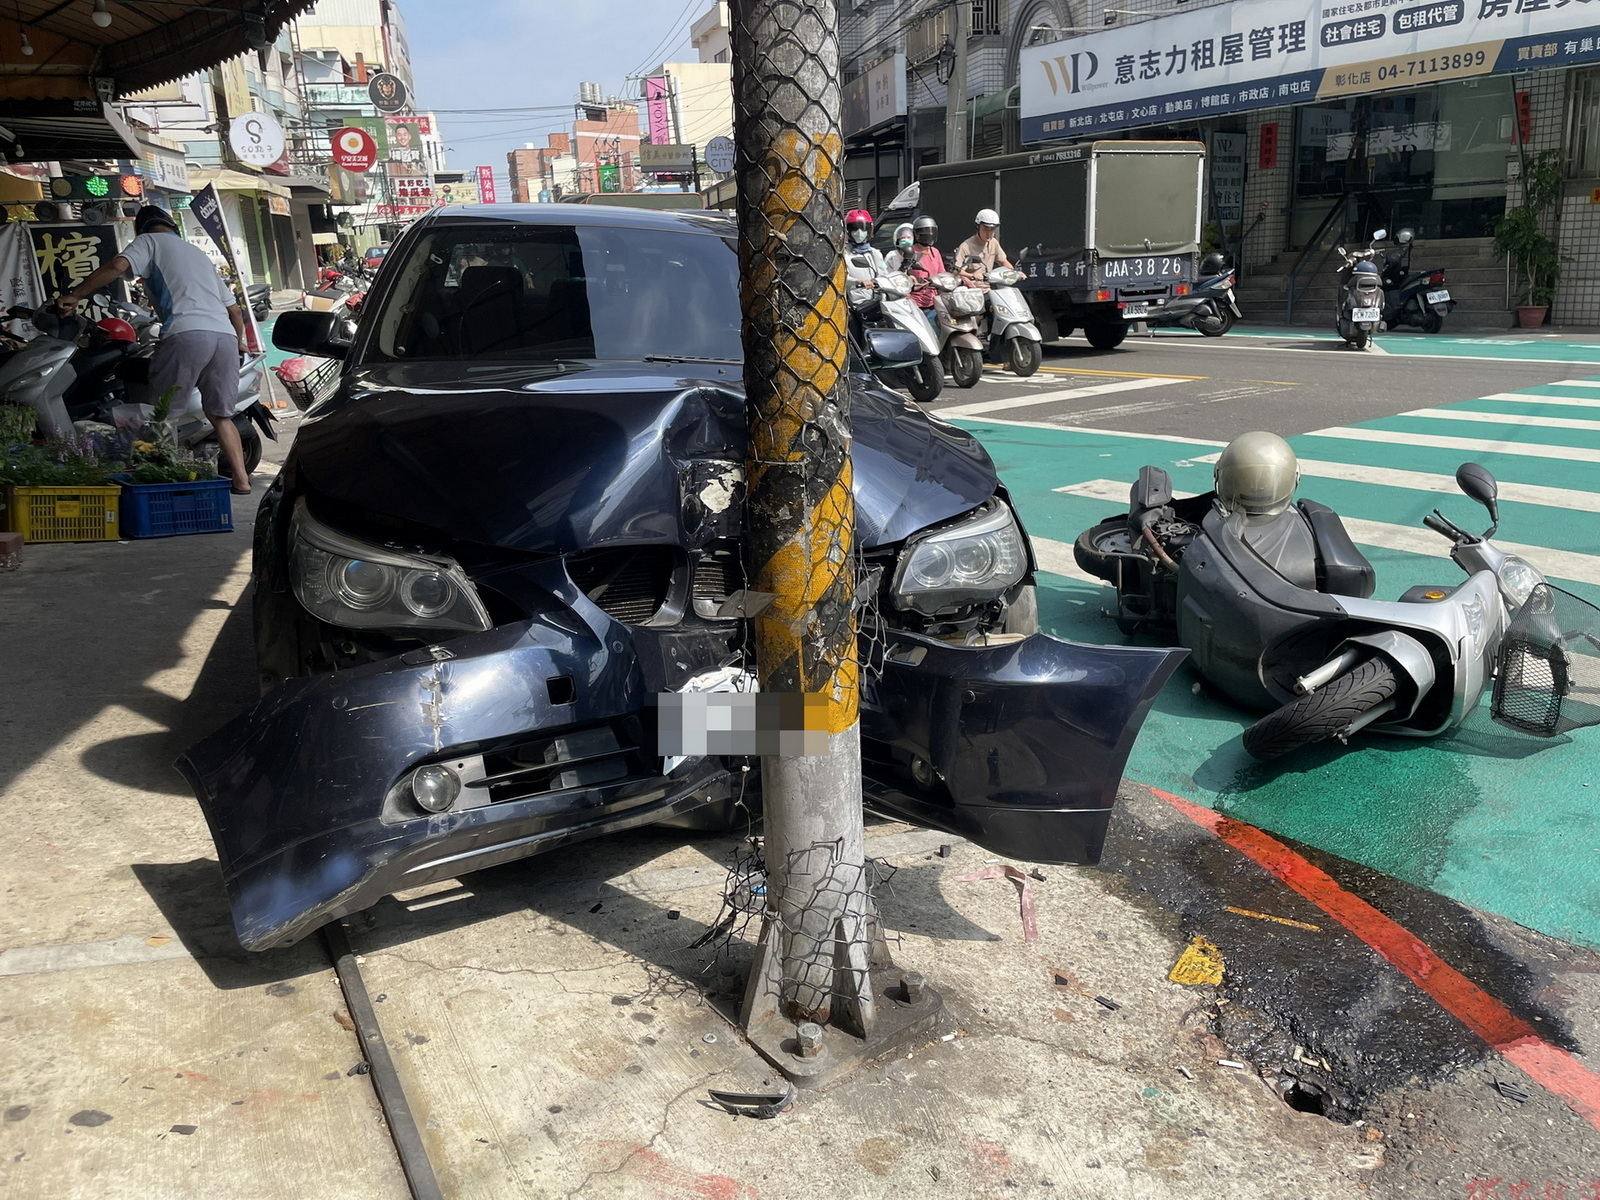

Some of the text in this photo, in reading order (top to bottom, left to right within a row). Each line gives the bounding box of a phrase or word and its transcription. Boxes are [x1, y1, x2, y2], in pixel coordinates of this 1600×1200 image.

[1398, 5, 1458, 29] 包租代管
[1325, 19, 1381, 43] 社會住宅
[1114, 19, 1306, 86] 意志力租屋管理
[1517, 42, 1559, 62] 買賣部
[1335, 50, 1487, 87] 彰化店 04-7113899
[653, 102, 665, 133] POYA
[1069, 115, 1093, 129] 新北店
[1099, 110, 1125, 124] 北屯店
[1131, 105, 1158, 119] 文心店
[1165, 99, 1193, 115] 勤美店
[1200, 93, 1230, 109] 博館店
[1238, 87, 1270, 103] 市政店
[1278, 80, 1312, 97] 南屯店
[710, 141, 733, 151] HAIR
